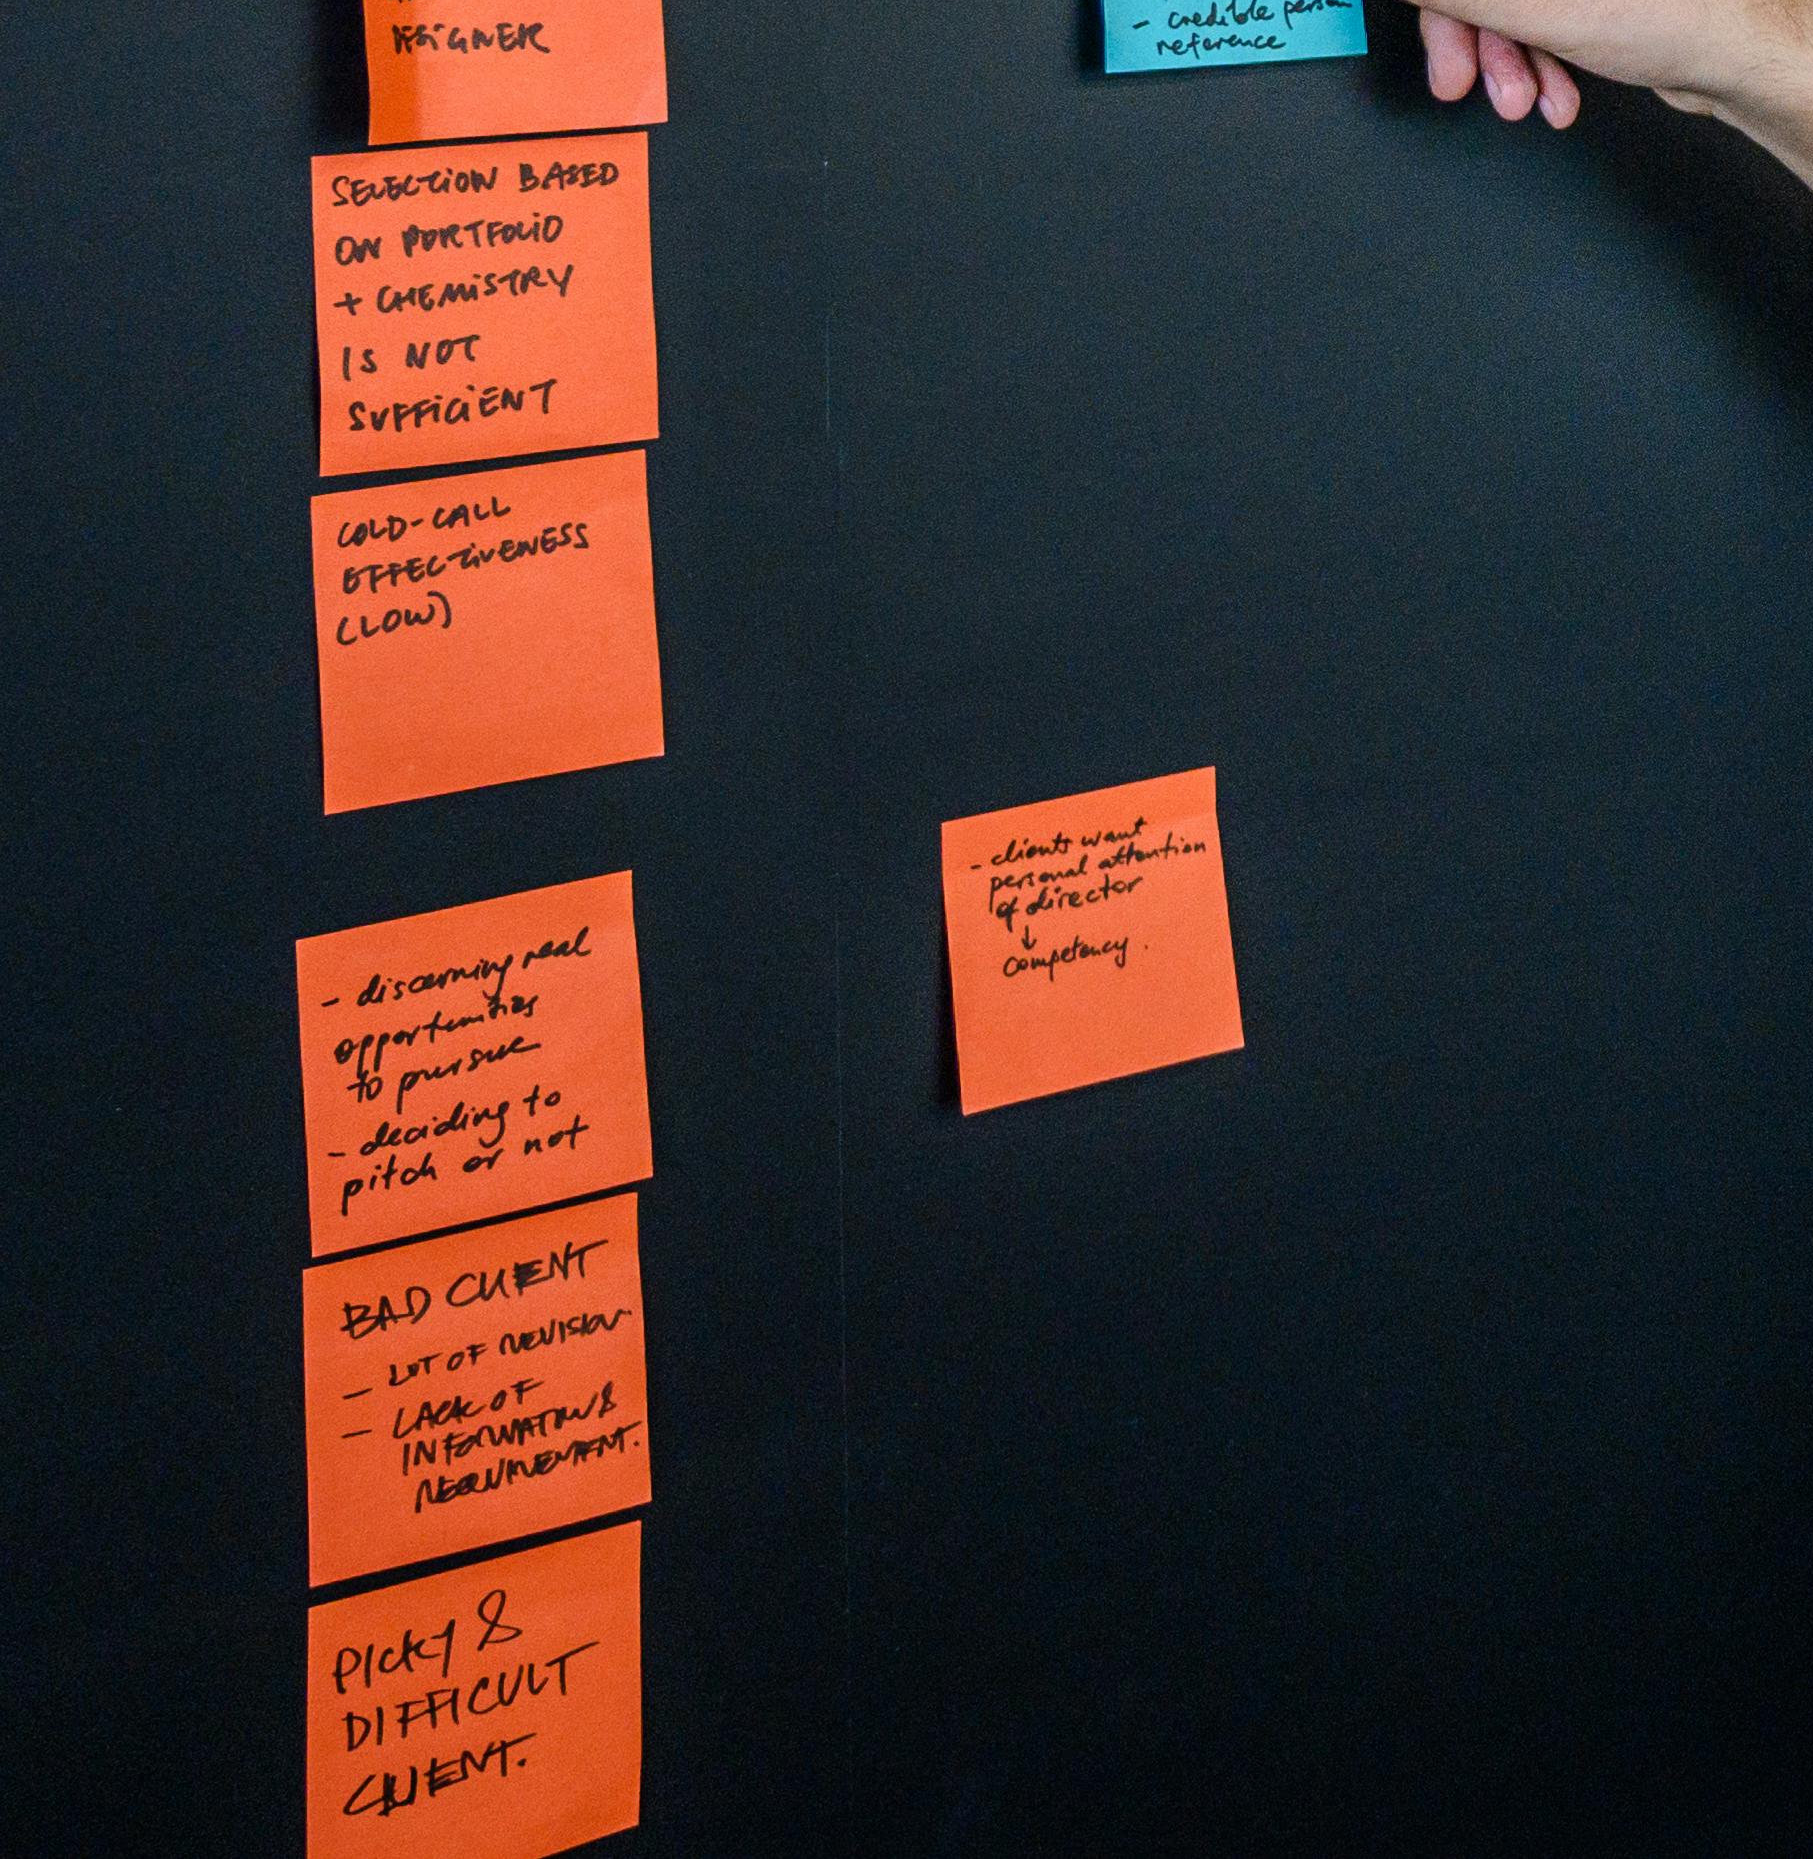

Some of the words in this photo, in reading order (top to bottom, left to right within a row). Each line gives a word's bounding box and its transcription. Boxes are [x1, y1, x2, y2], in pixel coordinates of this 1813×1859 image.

[1156, 34, 1288, 59] reference
[330, 164, 500, 208] SELECTION
[518, 160, 620, 194] BASED
[334, 234, 383, 268] ON
[400, 211, 566, 259] PORTFOLIO
[374, 262, 576, 315] CHEMISTRY
[341, 345, 379, 383] IS
[405, 332, 482, 371] NOT
[348, 376, 559, 434] SUFFICIENT
[341, 521, 591, 596] EFFECTIVENESS
[334, 590, 454, 647] (LOW)
[1080, 815, 1149, 848] want
[1025, 872, 1145, 917] director
[355, 952, 515, 1009] discerning
[521, 925, 593, 970] real
[333, 992, 541, 1074] opportunities
[346, 1071, 384, 1104] to
[395, 1035, 543, 1116] pursue
[359, 1099, 512, 1158] deciding
[522, 1083, 563, 1118] to
[340, 1152, 439, 1218] pitch
[460, 1146, 505, 1175] or
[522, 1113, 591, 1157] not
[340, 1284, 433, 1341] BAD
[444, 1238, 610, 1309] CLIENT
[387, 1351, 444, 1388] LOT
[446, 1341, 489, 1374] OF
[390, 1393, 488, 1441] LACK
[488, 1376, 546, 1412] OF
[331, 1617, 457, 1695] PICKY
[476, 1588, 524, 1653] &
[341, 1640, 601, 1753] DIFFICULT
